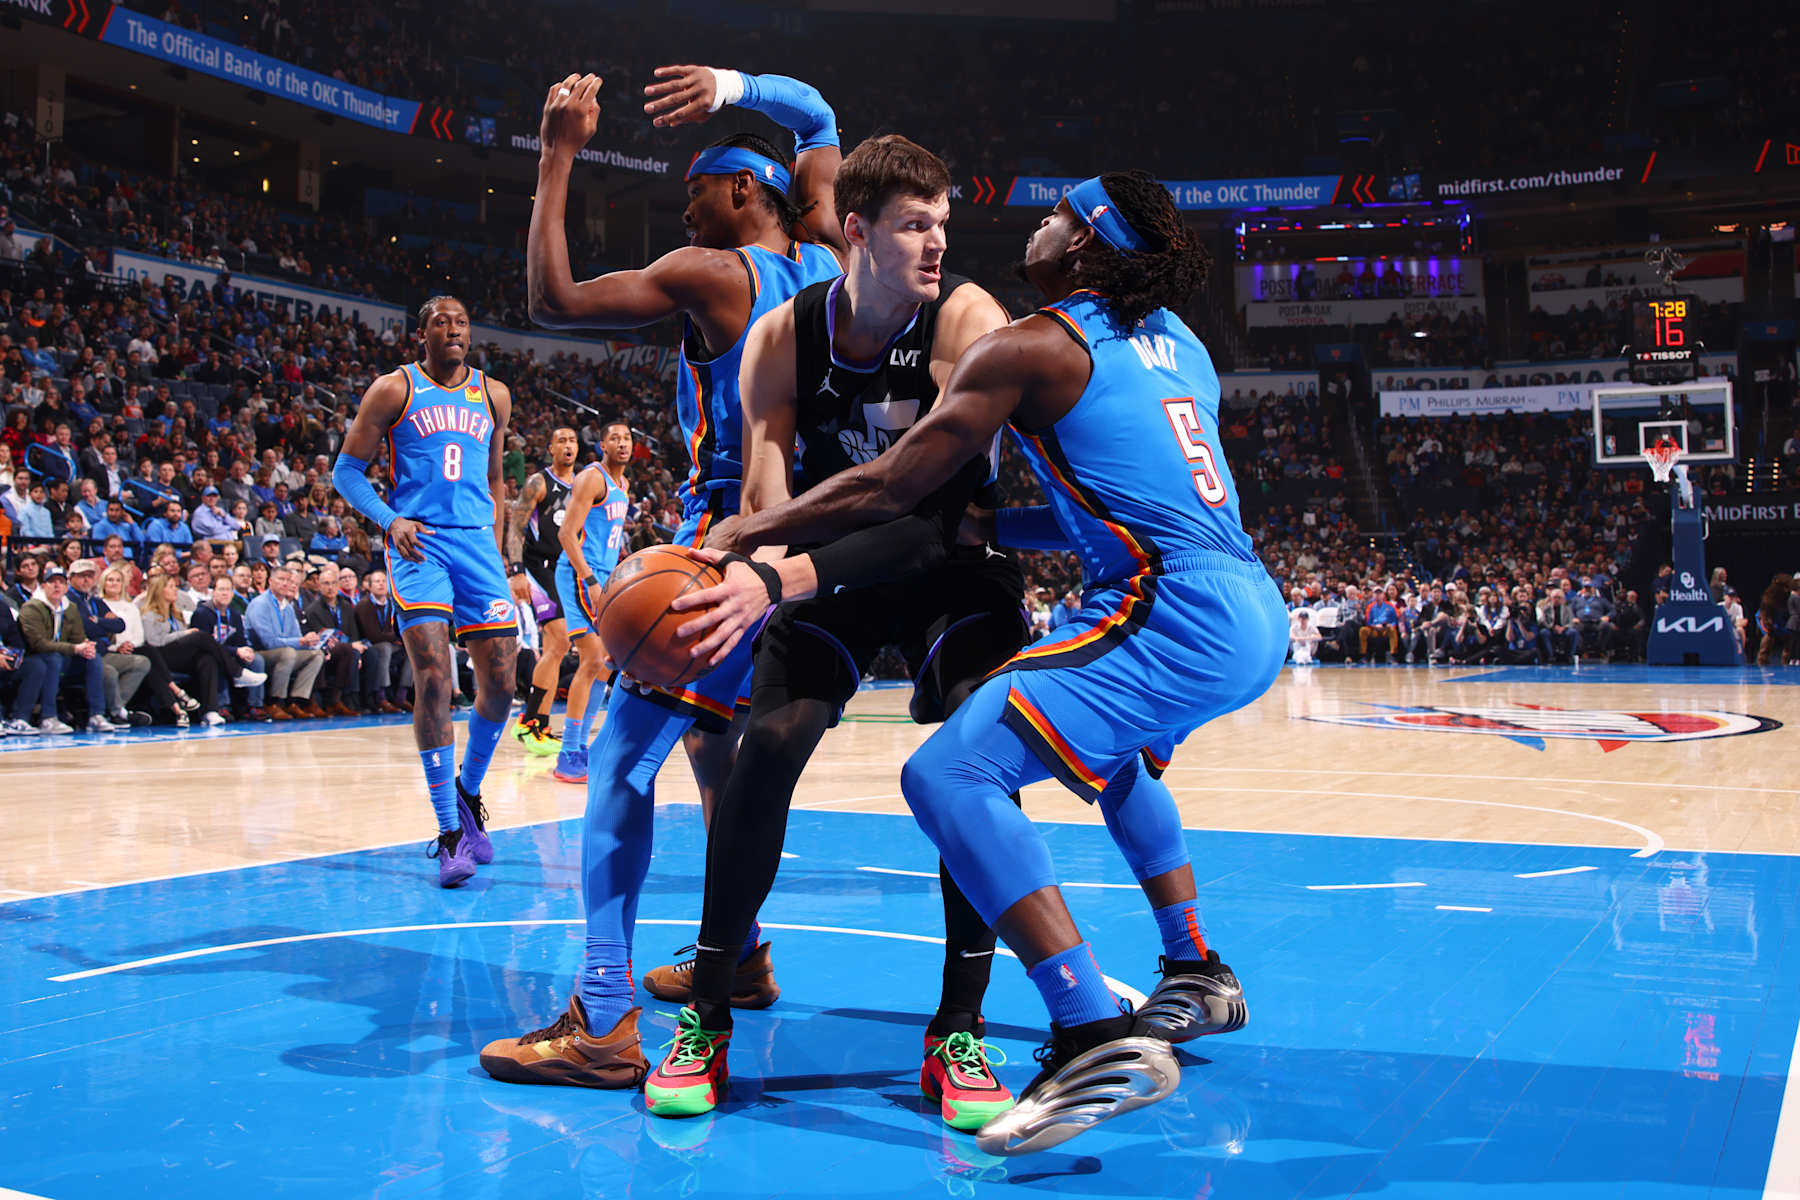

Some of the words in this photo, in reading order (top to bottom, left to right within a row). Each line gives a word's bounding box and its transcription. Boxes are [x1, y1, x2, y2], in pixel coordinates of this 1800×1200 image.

[127, 19, 157, 49] The
[162, 32, 219, 69] Official
[224, 51, 262, 83] Bank
[266, 67, 282, 89] of
[285, 72, 309, 97] the
[312, 81, 339, 108] OKC
[342, 90, 400, 125] Thunder
[1029, 183, 1057, 200] The
[1438, 166, 1624, 196] midfirst.com/thunder
[1186, 186, 1213, 204] the
[1217, 186, 1249, 202] OKC
[1253, 182, 1320, 201] Thunder
[1649, 301, 1686, 317] 7:28
[1655, 317, 1685, 347] 16
[890, 349, 921, 367] LVT
[1650, 351, 1691, 360] TISSOT
[408, 404, 490, 443] THUNDER
[443, 442, 463, 482] 8
[1160, 397, 1227, 508] 5
[1670, 589, 1708, 601] Health
[1657, 617, 1723, 632] KIA
